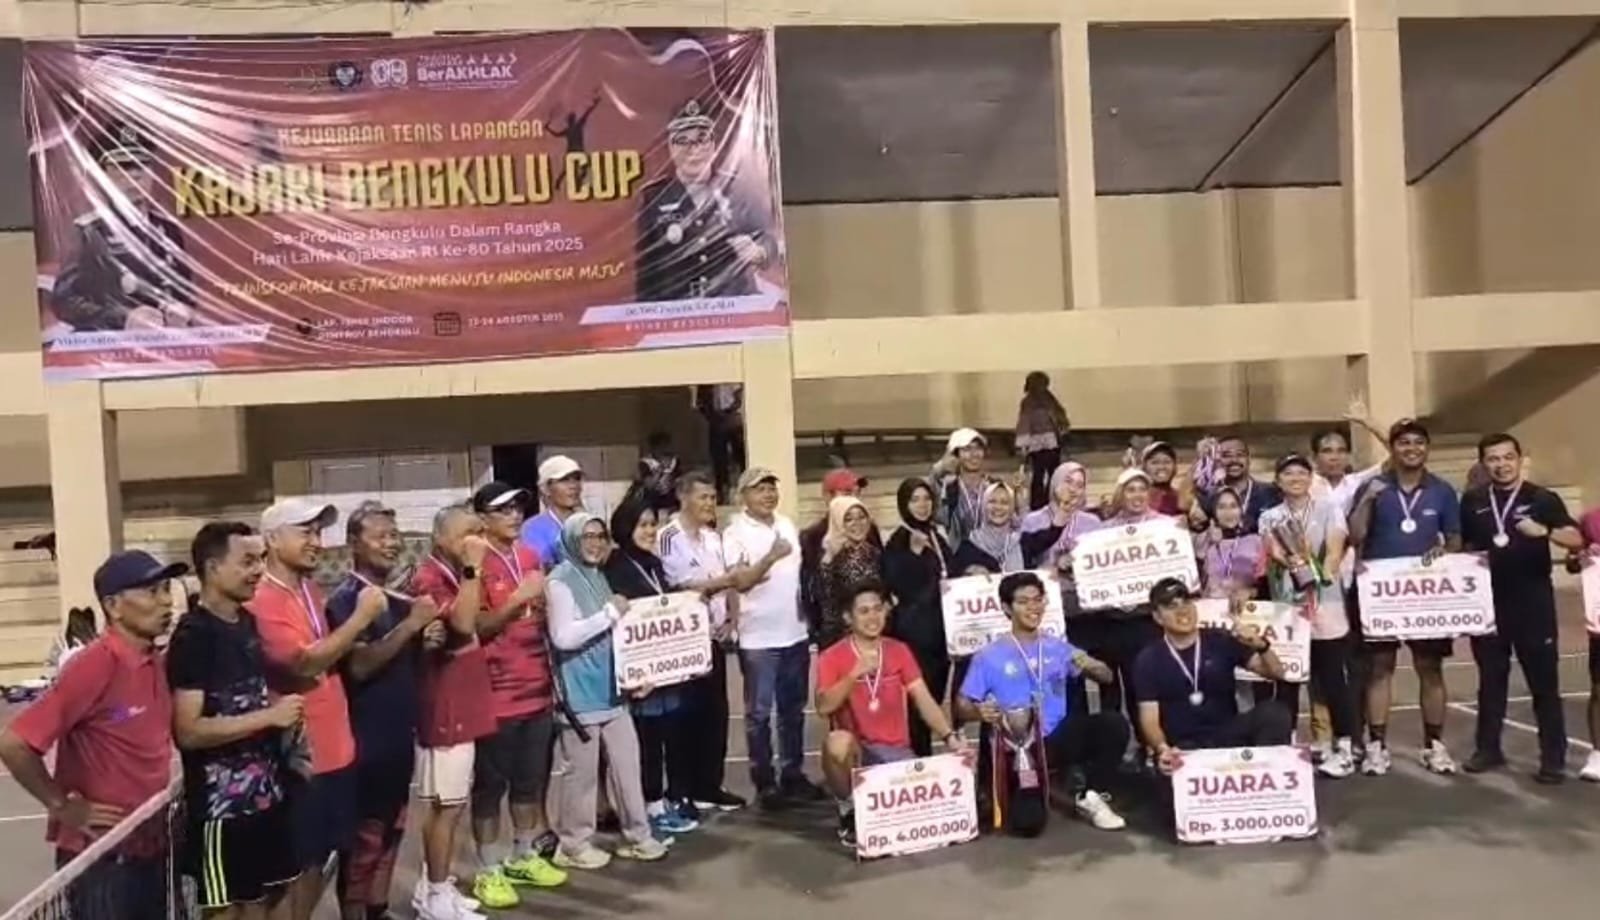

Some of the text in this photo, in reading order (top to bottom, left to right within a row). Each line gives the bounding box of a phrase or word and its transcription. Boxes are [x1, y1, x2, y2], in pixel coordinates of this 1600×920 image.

[417, 65, 513, 82] BerAKHLAK
[278, 119, 545, 148] KEJUARAAN TENIS LAPANGAN
[172, 148, 646, 218] KAJARI BENGKULU CUP
[370, 226, 446, 245] Bengkulu
[449, 222, 501, 238] Dalam
[504, 219, 563, 238] Rangka
[253, 250, 287, 266] Hari
[336, 245, 416, 265] Kejaksaan
[420, 245, 437, 258] RI
[441, 242, 489, 257] Ke-80
[492, 239, 543, 255] Tahun
[545, 237, 585, 253] 2025
[429, 272, 494, 288] MENUJU
[497, 266, 575, 284] INDONESIA
[372, 315, 414, 326] INDOOR
[1082, 543, 1161, 571] JUARA
[1166, 538, 1180, 556] 2
[1090, 588, 1115, 602] Rp.
[1371, 575, 1478, 598] JUARA 3
[955, 595, 1000, 617] JUA
[624, 613, 700, 646] JUARA 3
[1284, 624, 1295, 642] 1
[1372, 613, 1483, 631] Rp. 3.000.000
[627, 652, 705, 682] Rp. 1.000.000
[866, 781, 945, 812] JUARA
[949, 777, 963, 798] 2
[1187, 770, 1299, 797] JUARA 3
[867, 818, 970, 851] Rp. 4.000.000
[1188, 813, 1306, 836] Rp. 3.000.000
